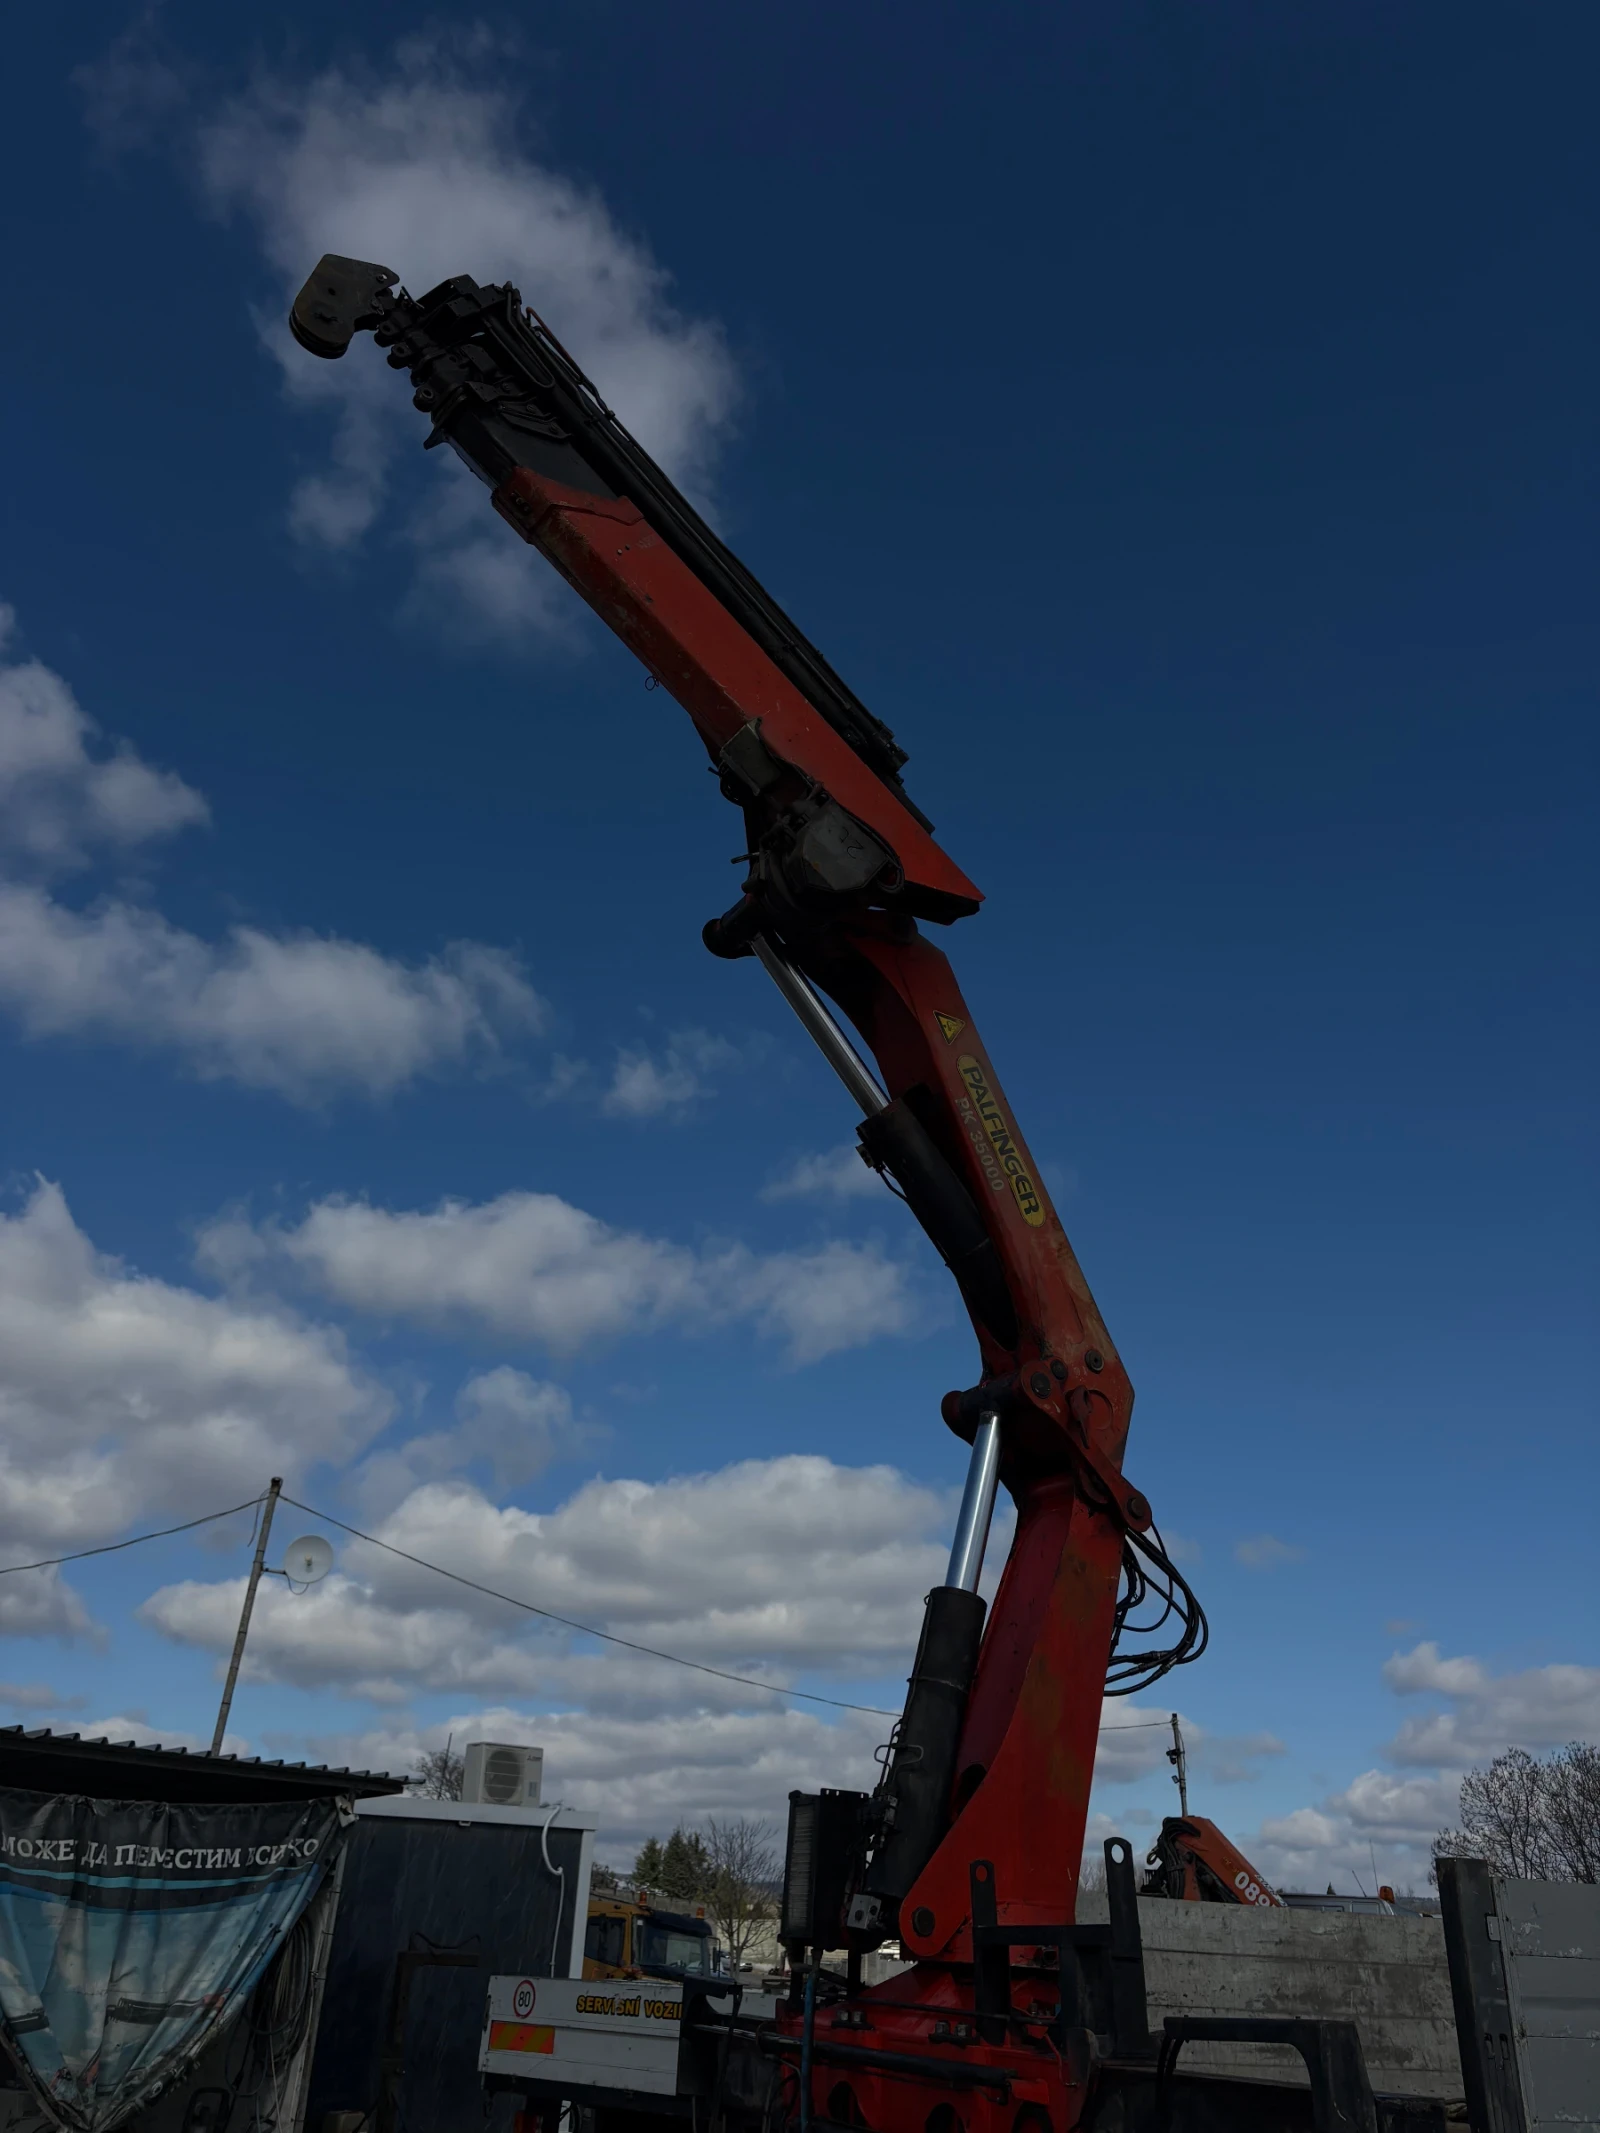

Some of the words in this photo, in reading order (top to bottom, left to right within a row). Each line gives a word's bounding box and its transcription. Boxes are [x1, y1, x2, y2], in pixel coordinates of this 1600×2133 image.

[955, 1097, 978, 1125] PK
[969, 1130, 1005, 1191] 35000
[962, 1065, 1041, 1216] PALFINGER
[1, 1831, 79, 1861] МОЖЕ
[80, 1840, 108, 1868] ДА
[113, 1843, 242, 1869] ПЕМЕСТИМ
[244, 1837, 320, 1867] ВСИКО
[1234, 1871, 1277, 1907] 089
[518, 1991, 531, 2007] 80
